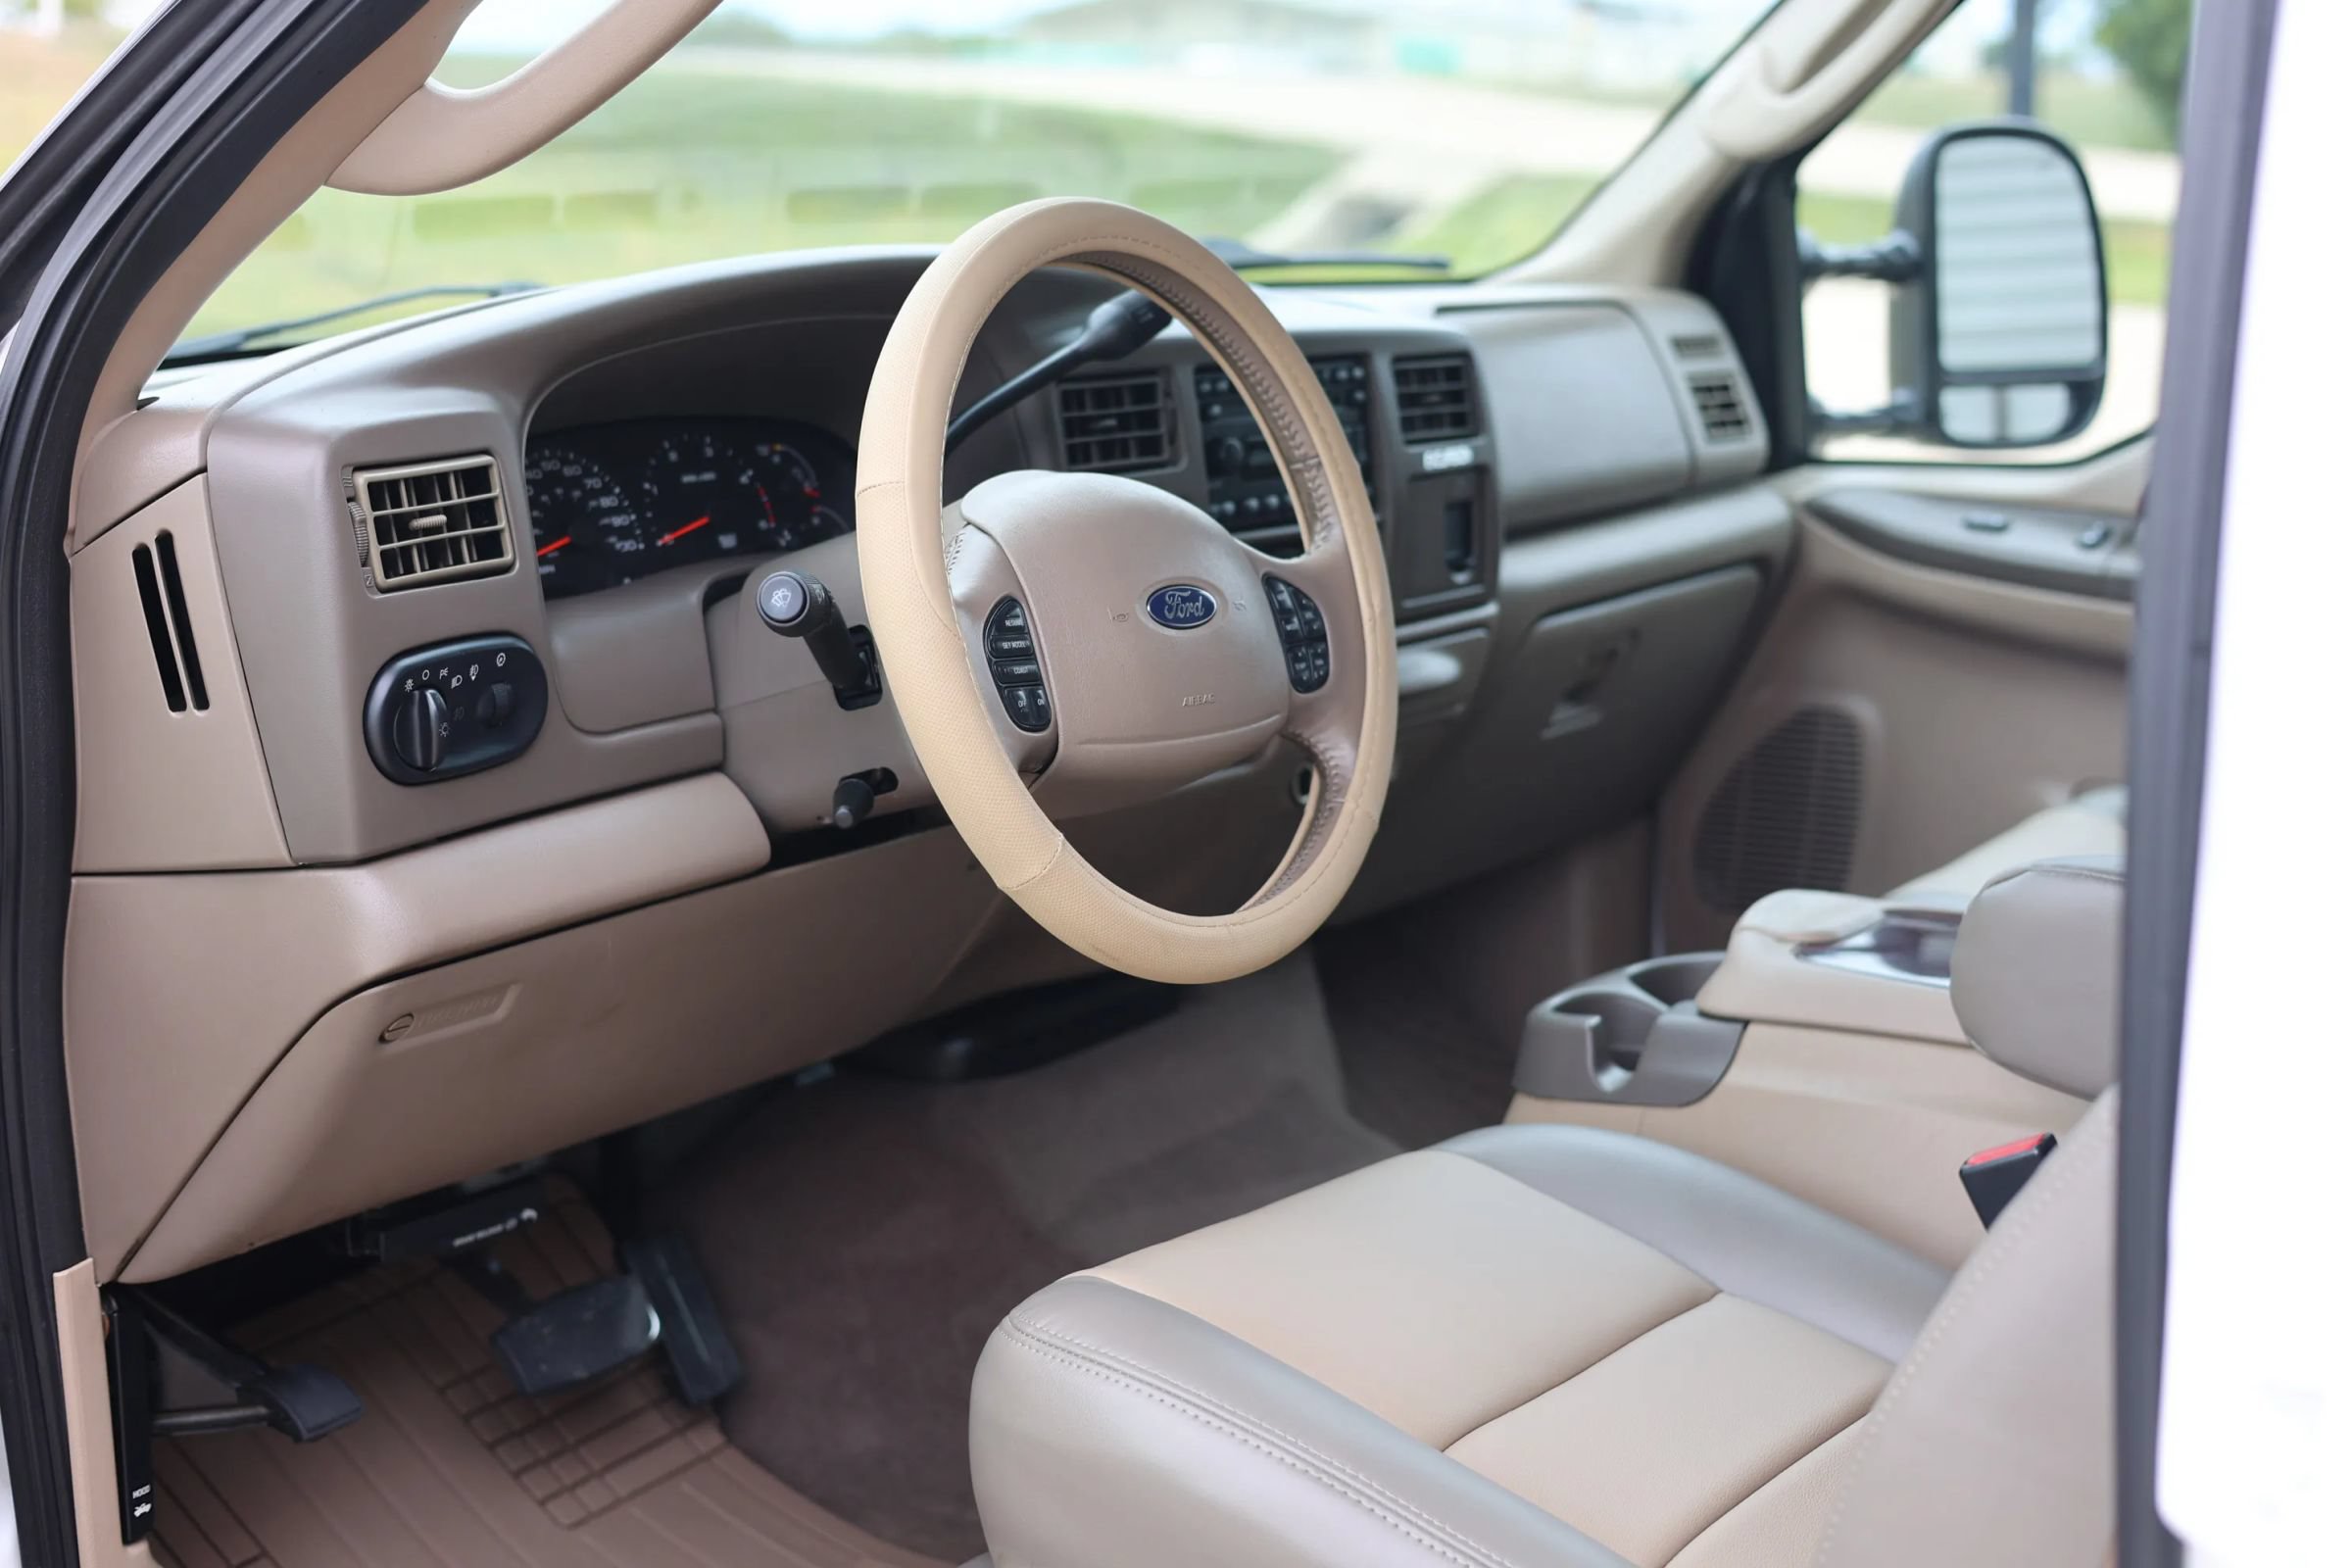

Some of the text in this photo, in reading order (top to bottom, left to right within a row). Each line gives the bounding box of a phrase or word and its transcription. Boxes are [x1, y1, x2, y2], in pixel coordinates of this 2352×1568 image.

[584, 477, 603, 489] 70
[599, 496, 619, 509] 80
[611, 514, 630, 527] 90
[1163, 590, 1205, 619] Ford
